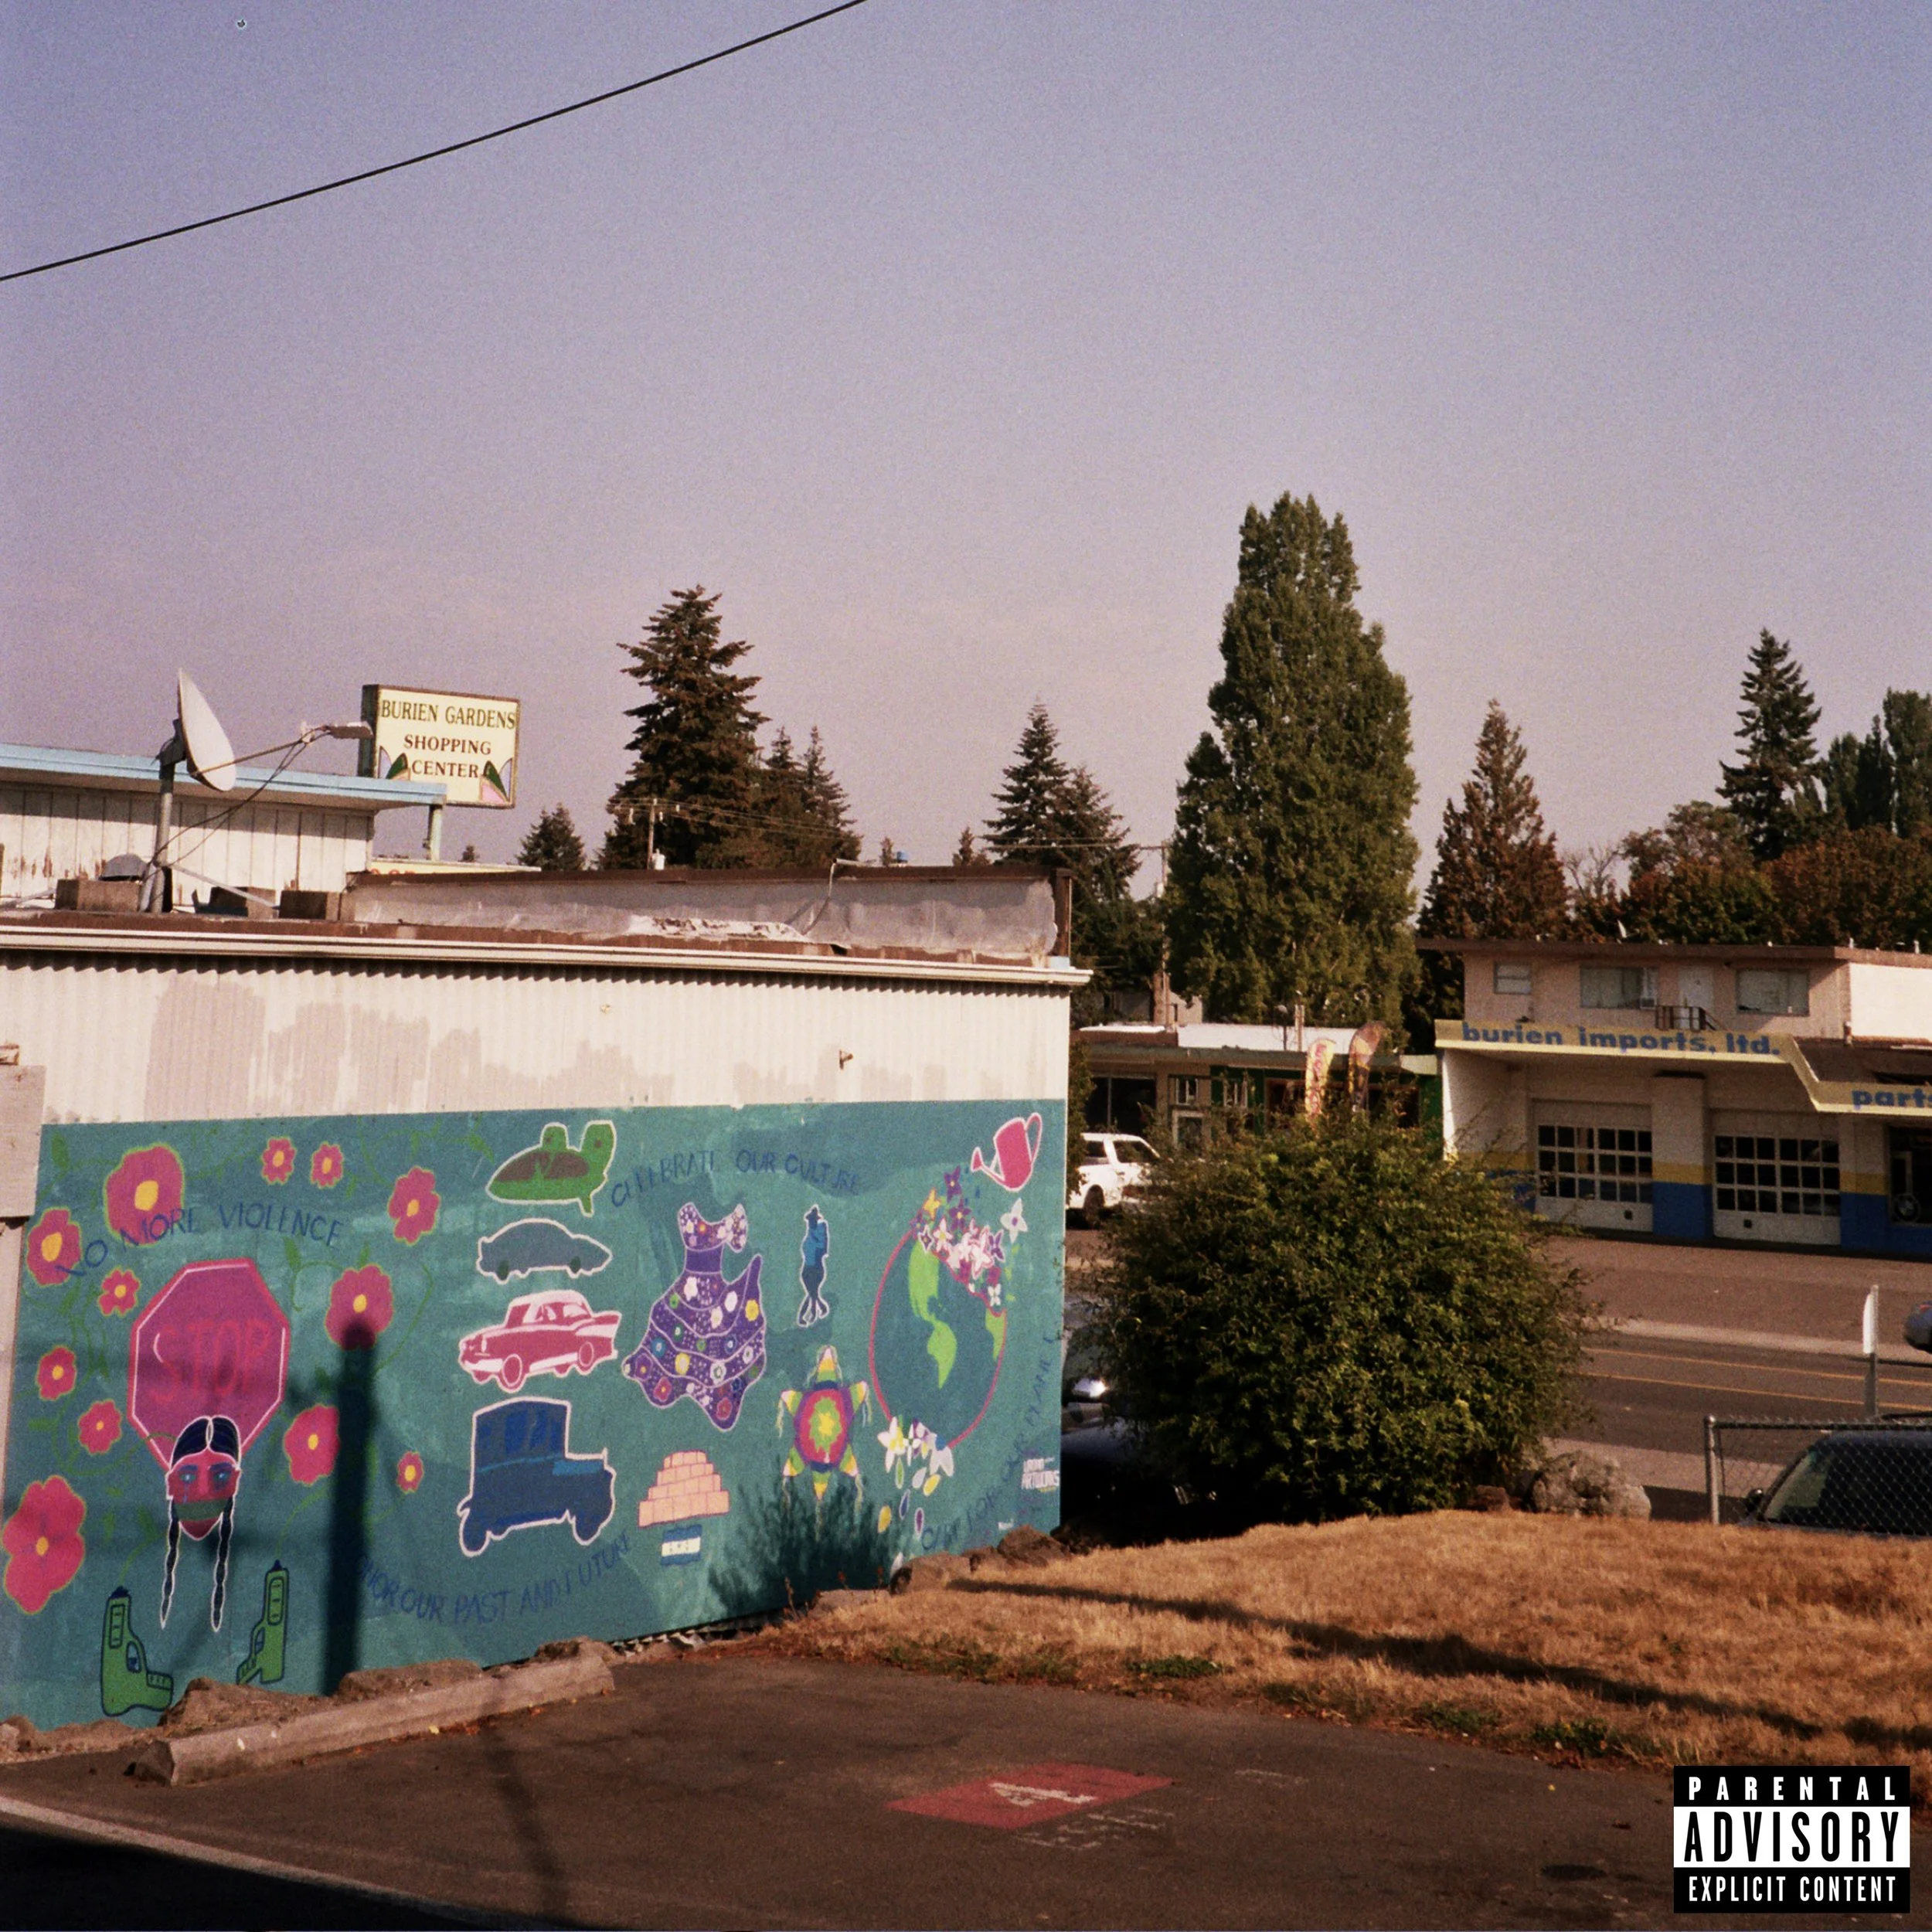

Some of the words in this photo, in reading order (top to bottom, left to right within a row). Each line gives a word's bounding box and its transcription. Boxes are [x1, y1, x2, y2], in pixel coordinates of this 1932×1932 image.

[381, 699, 439, 723] BURIEN
[445, 706, 516, 730] GARDENS
[403, 734, 492, 755] SHOPPING
[411, 760, 479, 778] CENTER
[1461, 1022, 1563, 1046] burien
[1726, 1032, 1781, 1056] ltd.
[1852, 1087, 1932, 1111] part
[736, 1148, 776, 1174] OUR
[148, 1318, 270, 1404] STOP
[454, 1590, 512, 1624] PAST
